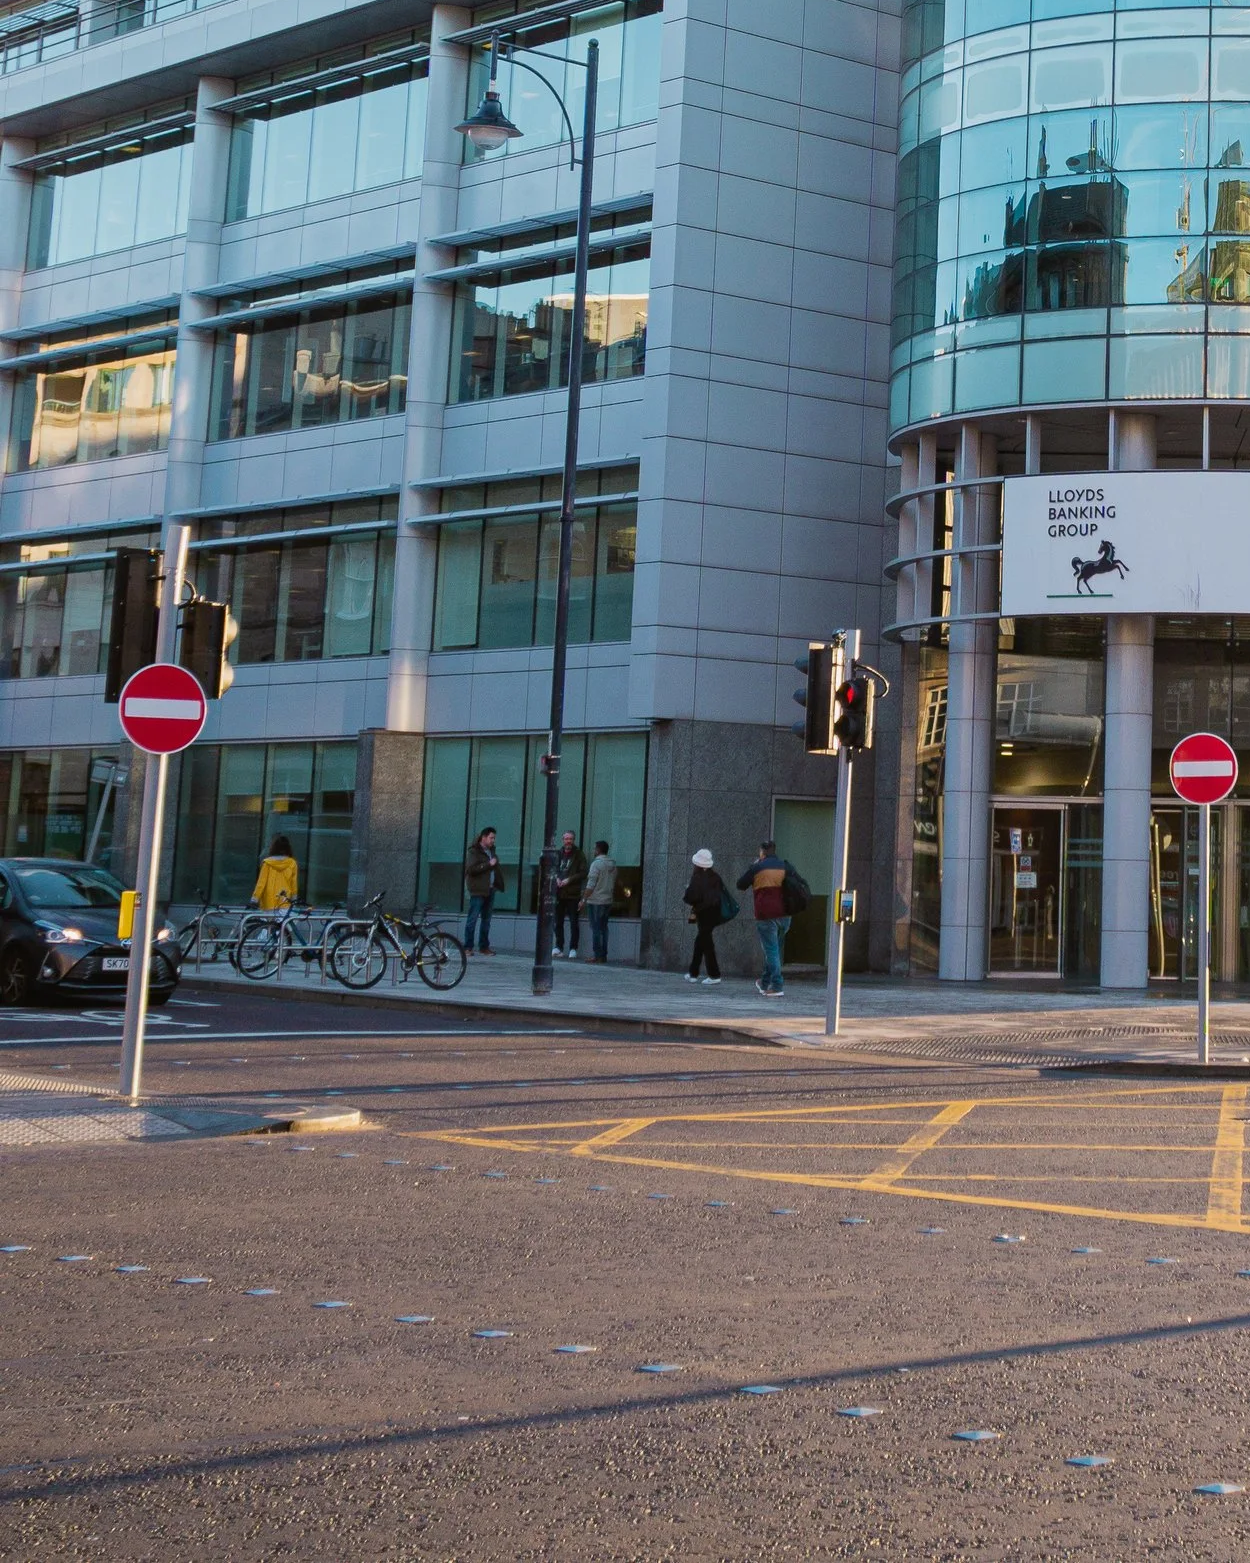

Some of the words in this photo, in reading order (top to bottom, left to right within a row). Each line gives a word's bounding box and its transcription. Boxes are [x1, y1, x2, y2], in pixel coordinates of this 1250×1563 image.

[1048, 488, 1105, 503] LLOYDS
[1048, 505, 1117, 520] BANKING
[1048, 523, 1098, 538] GROUP
[106, 959, 129, 968] SK70
